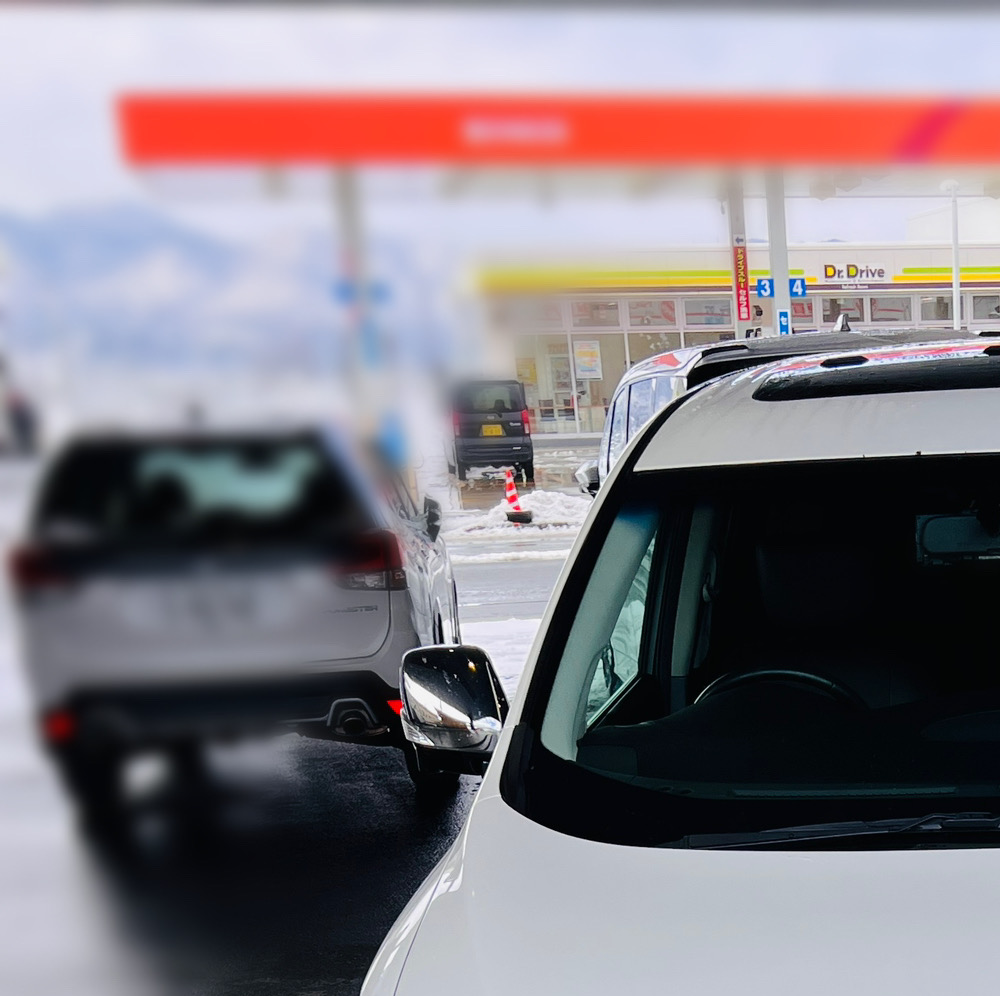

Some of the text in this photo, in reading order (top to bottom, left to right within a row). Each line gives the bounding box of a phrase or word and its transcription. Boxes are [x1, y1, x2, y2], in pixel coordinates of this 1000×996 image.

[824, 264, 885, 278] Dr. Drive
[760, 280, 771, 296] 3
[792, 280, 803, 296] 4
